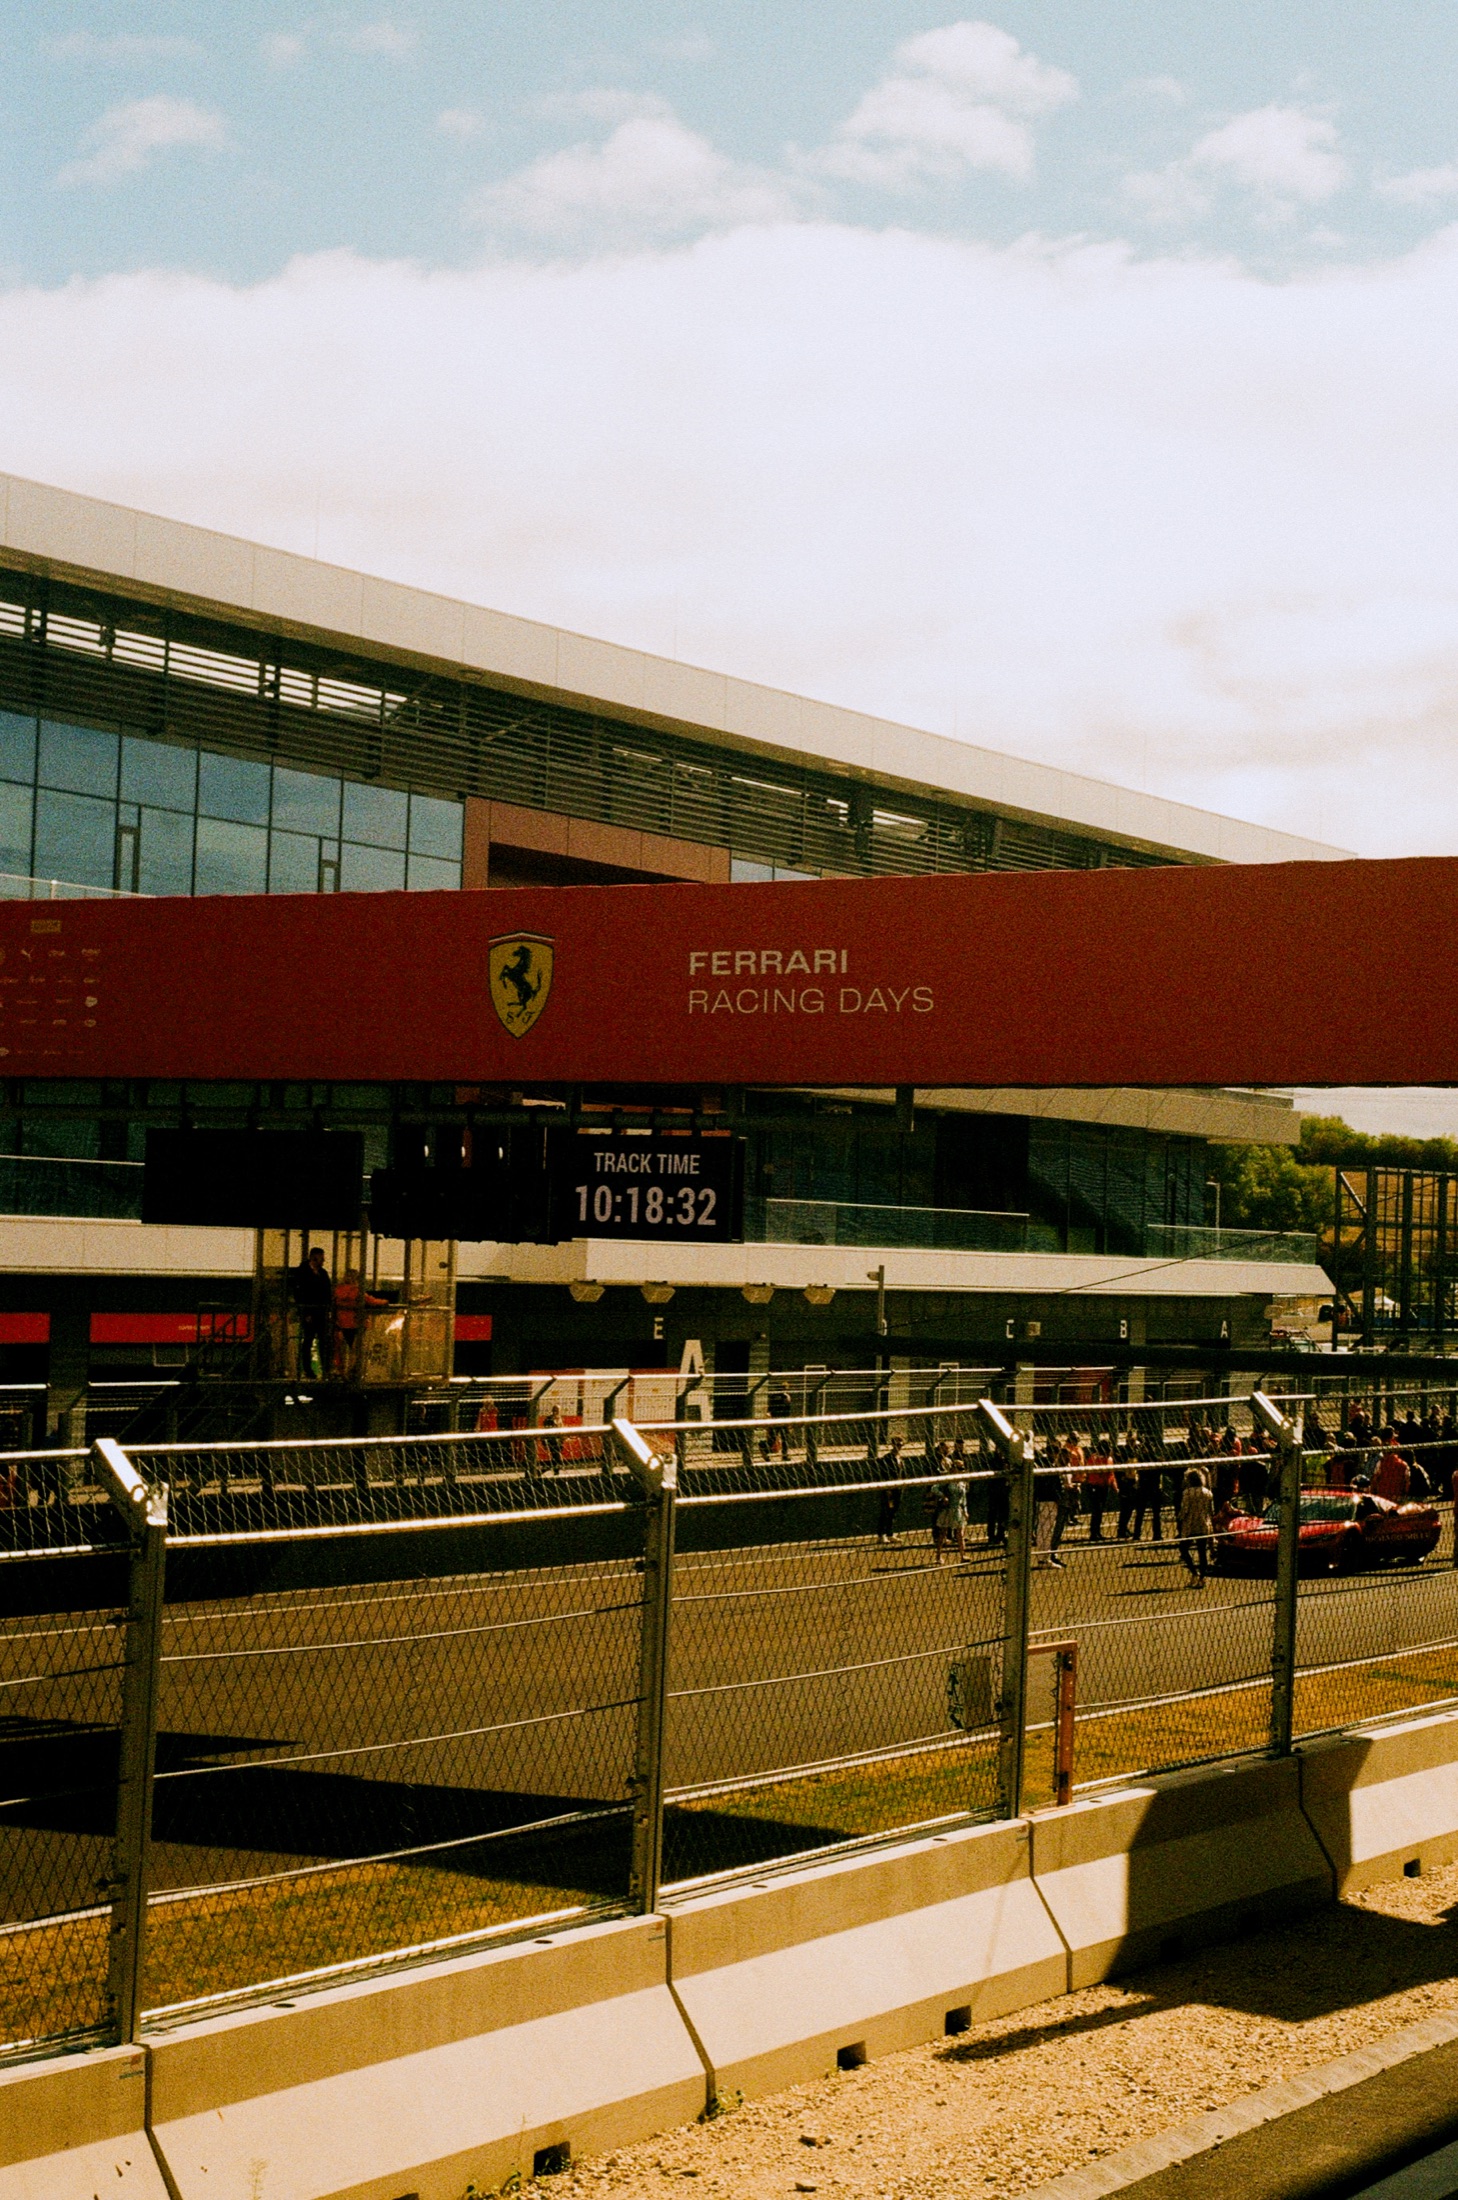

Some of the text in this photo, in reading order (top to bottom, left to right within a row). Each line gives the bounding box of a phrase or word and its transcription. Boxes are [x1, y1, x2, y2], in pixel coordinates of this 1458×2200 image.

[689, 949, 848, 975] FERRARI
[688, 986, 934, 1014] RACING DAYS
[594, 1152, 701, 1174] TRACK TIME
[575, 1185, 717, 1226] 10:18:32
[653, 1317, 664, 1340] E
[1120, 1319, 1128, 1339] B
[1220, 1320, 1229, 1338] A
